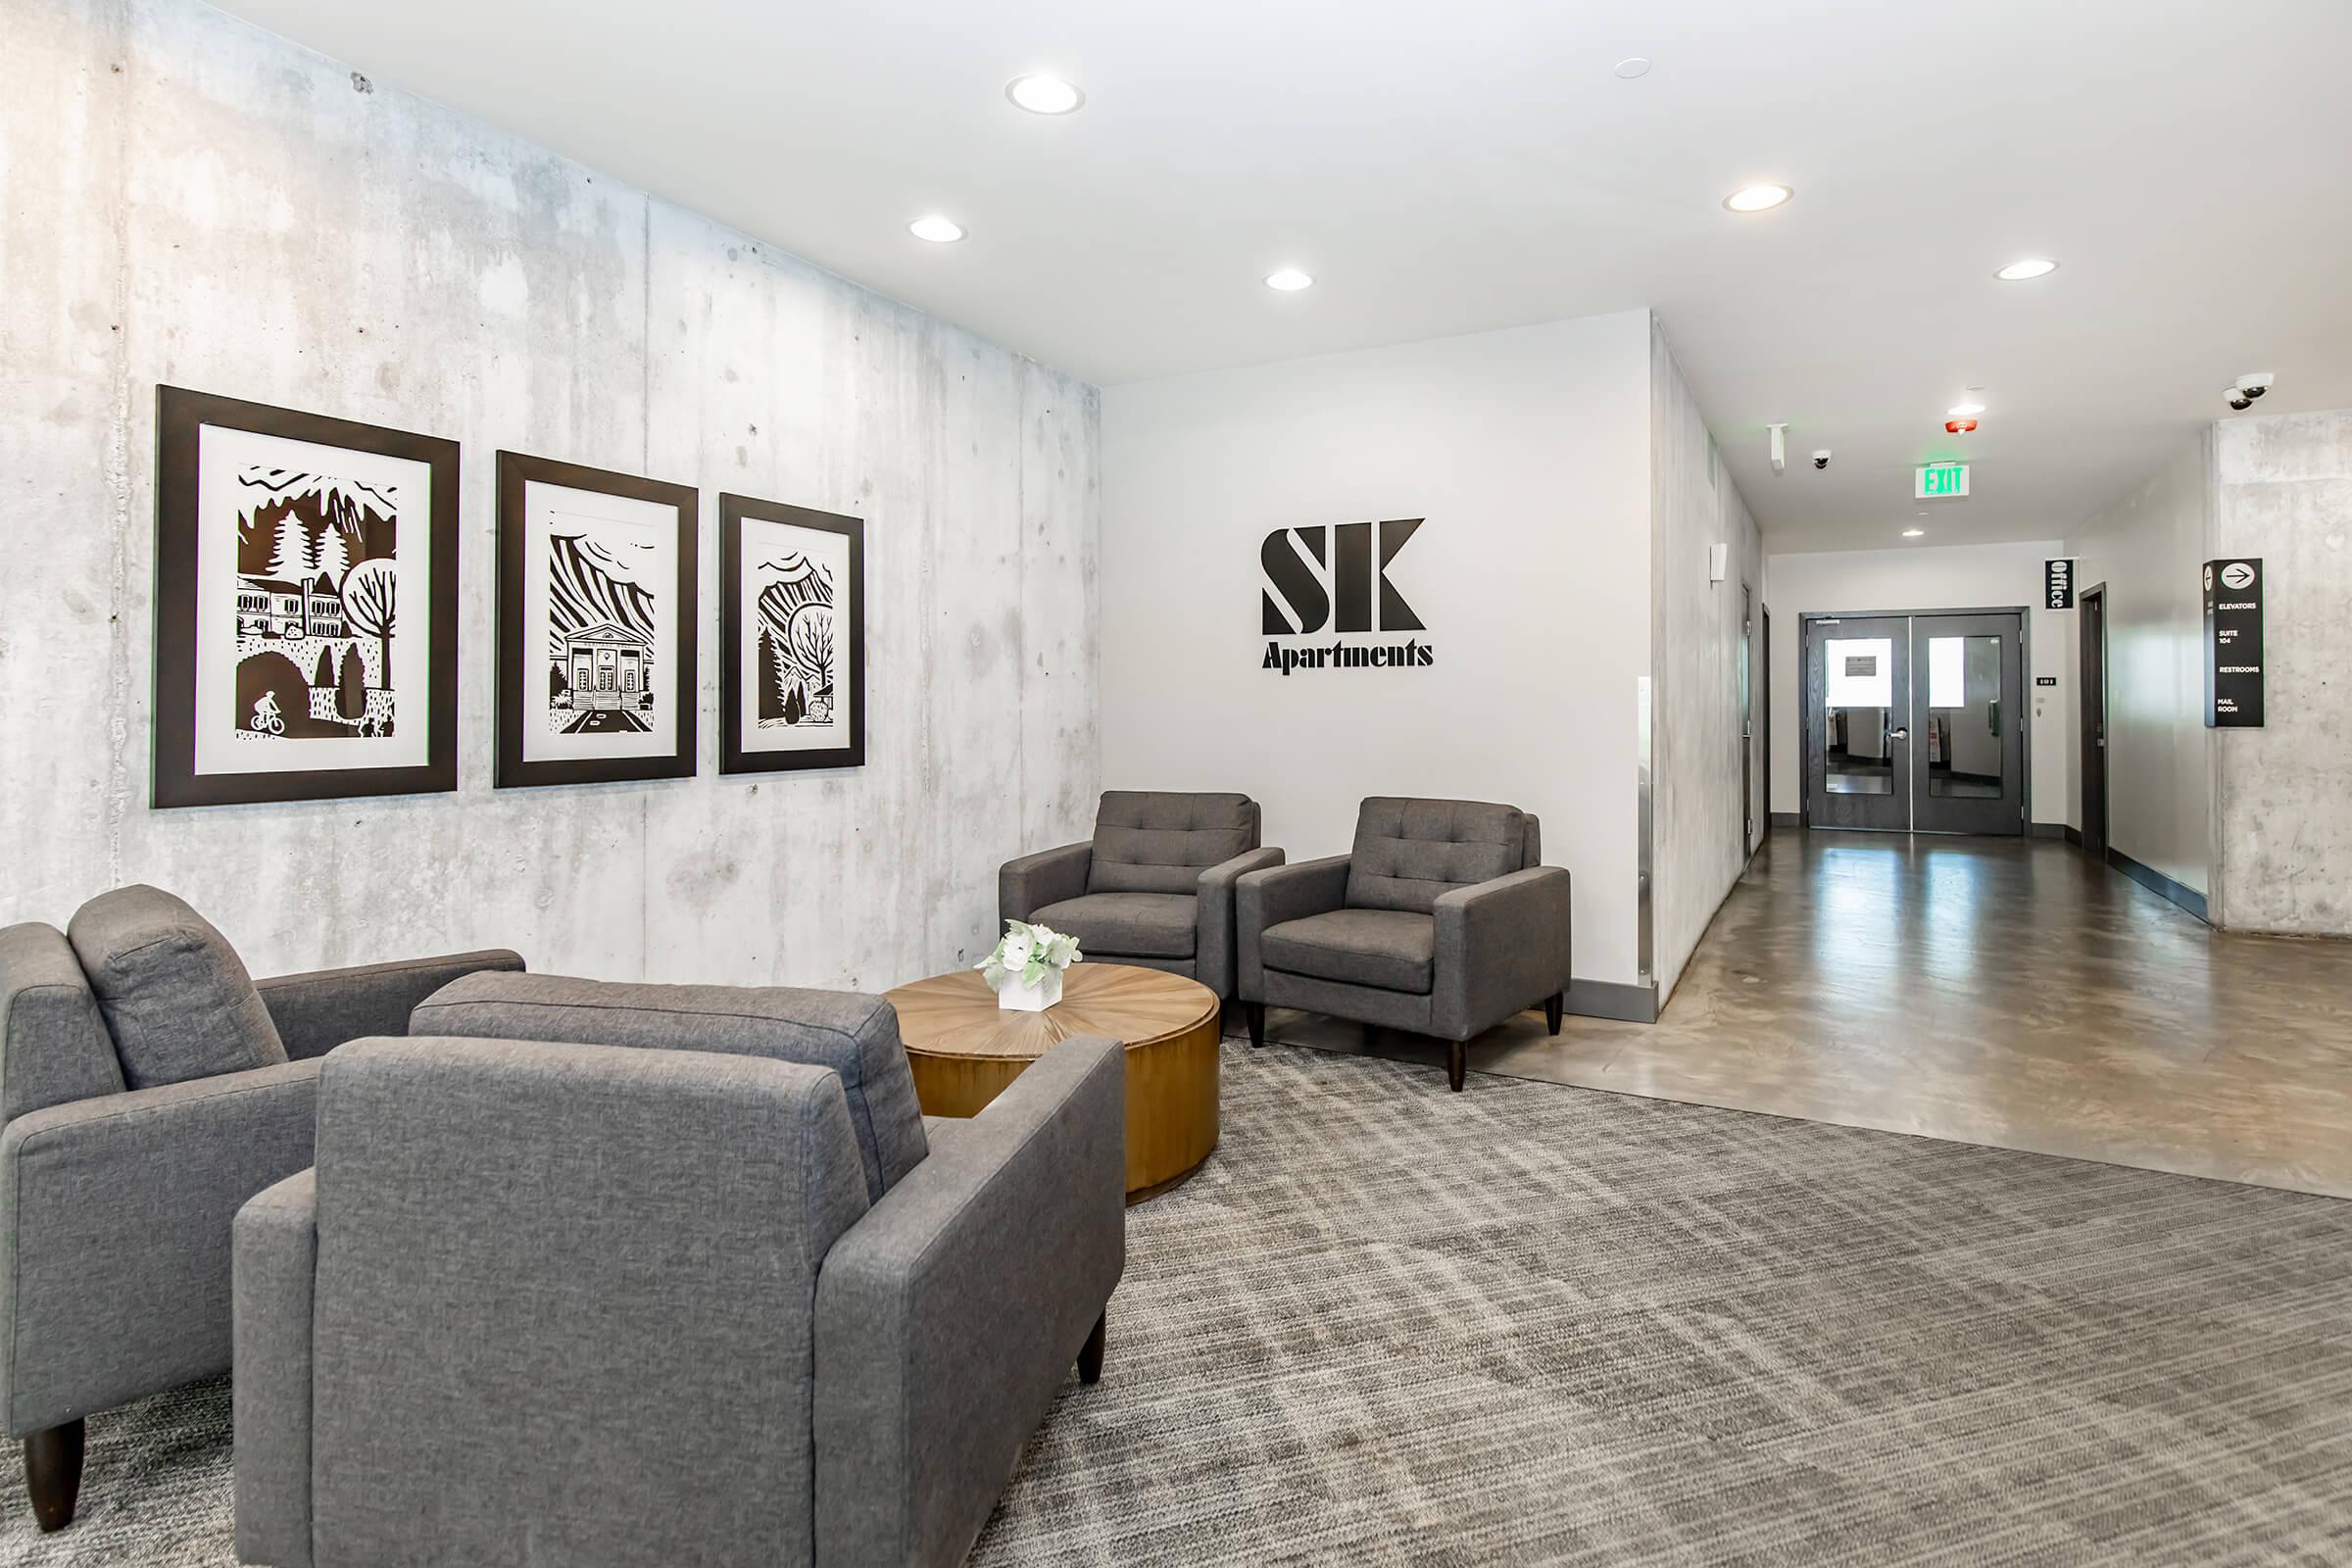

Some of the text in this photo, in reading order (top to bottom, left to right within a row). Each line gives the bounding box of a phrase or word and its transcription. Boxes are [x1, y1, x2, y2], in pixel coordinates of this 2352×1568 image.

[1924, 466, 1963, 495] EXIT
[1261, 517, 1427, 635] SK
[2051, 561, 2067, 608] Office
[1261, 638, 1434, 675] Apartments
